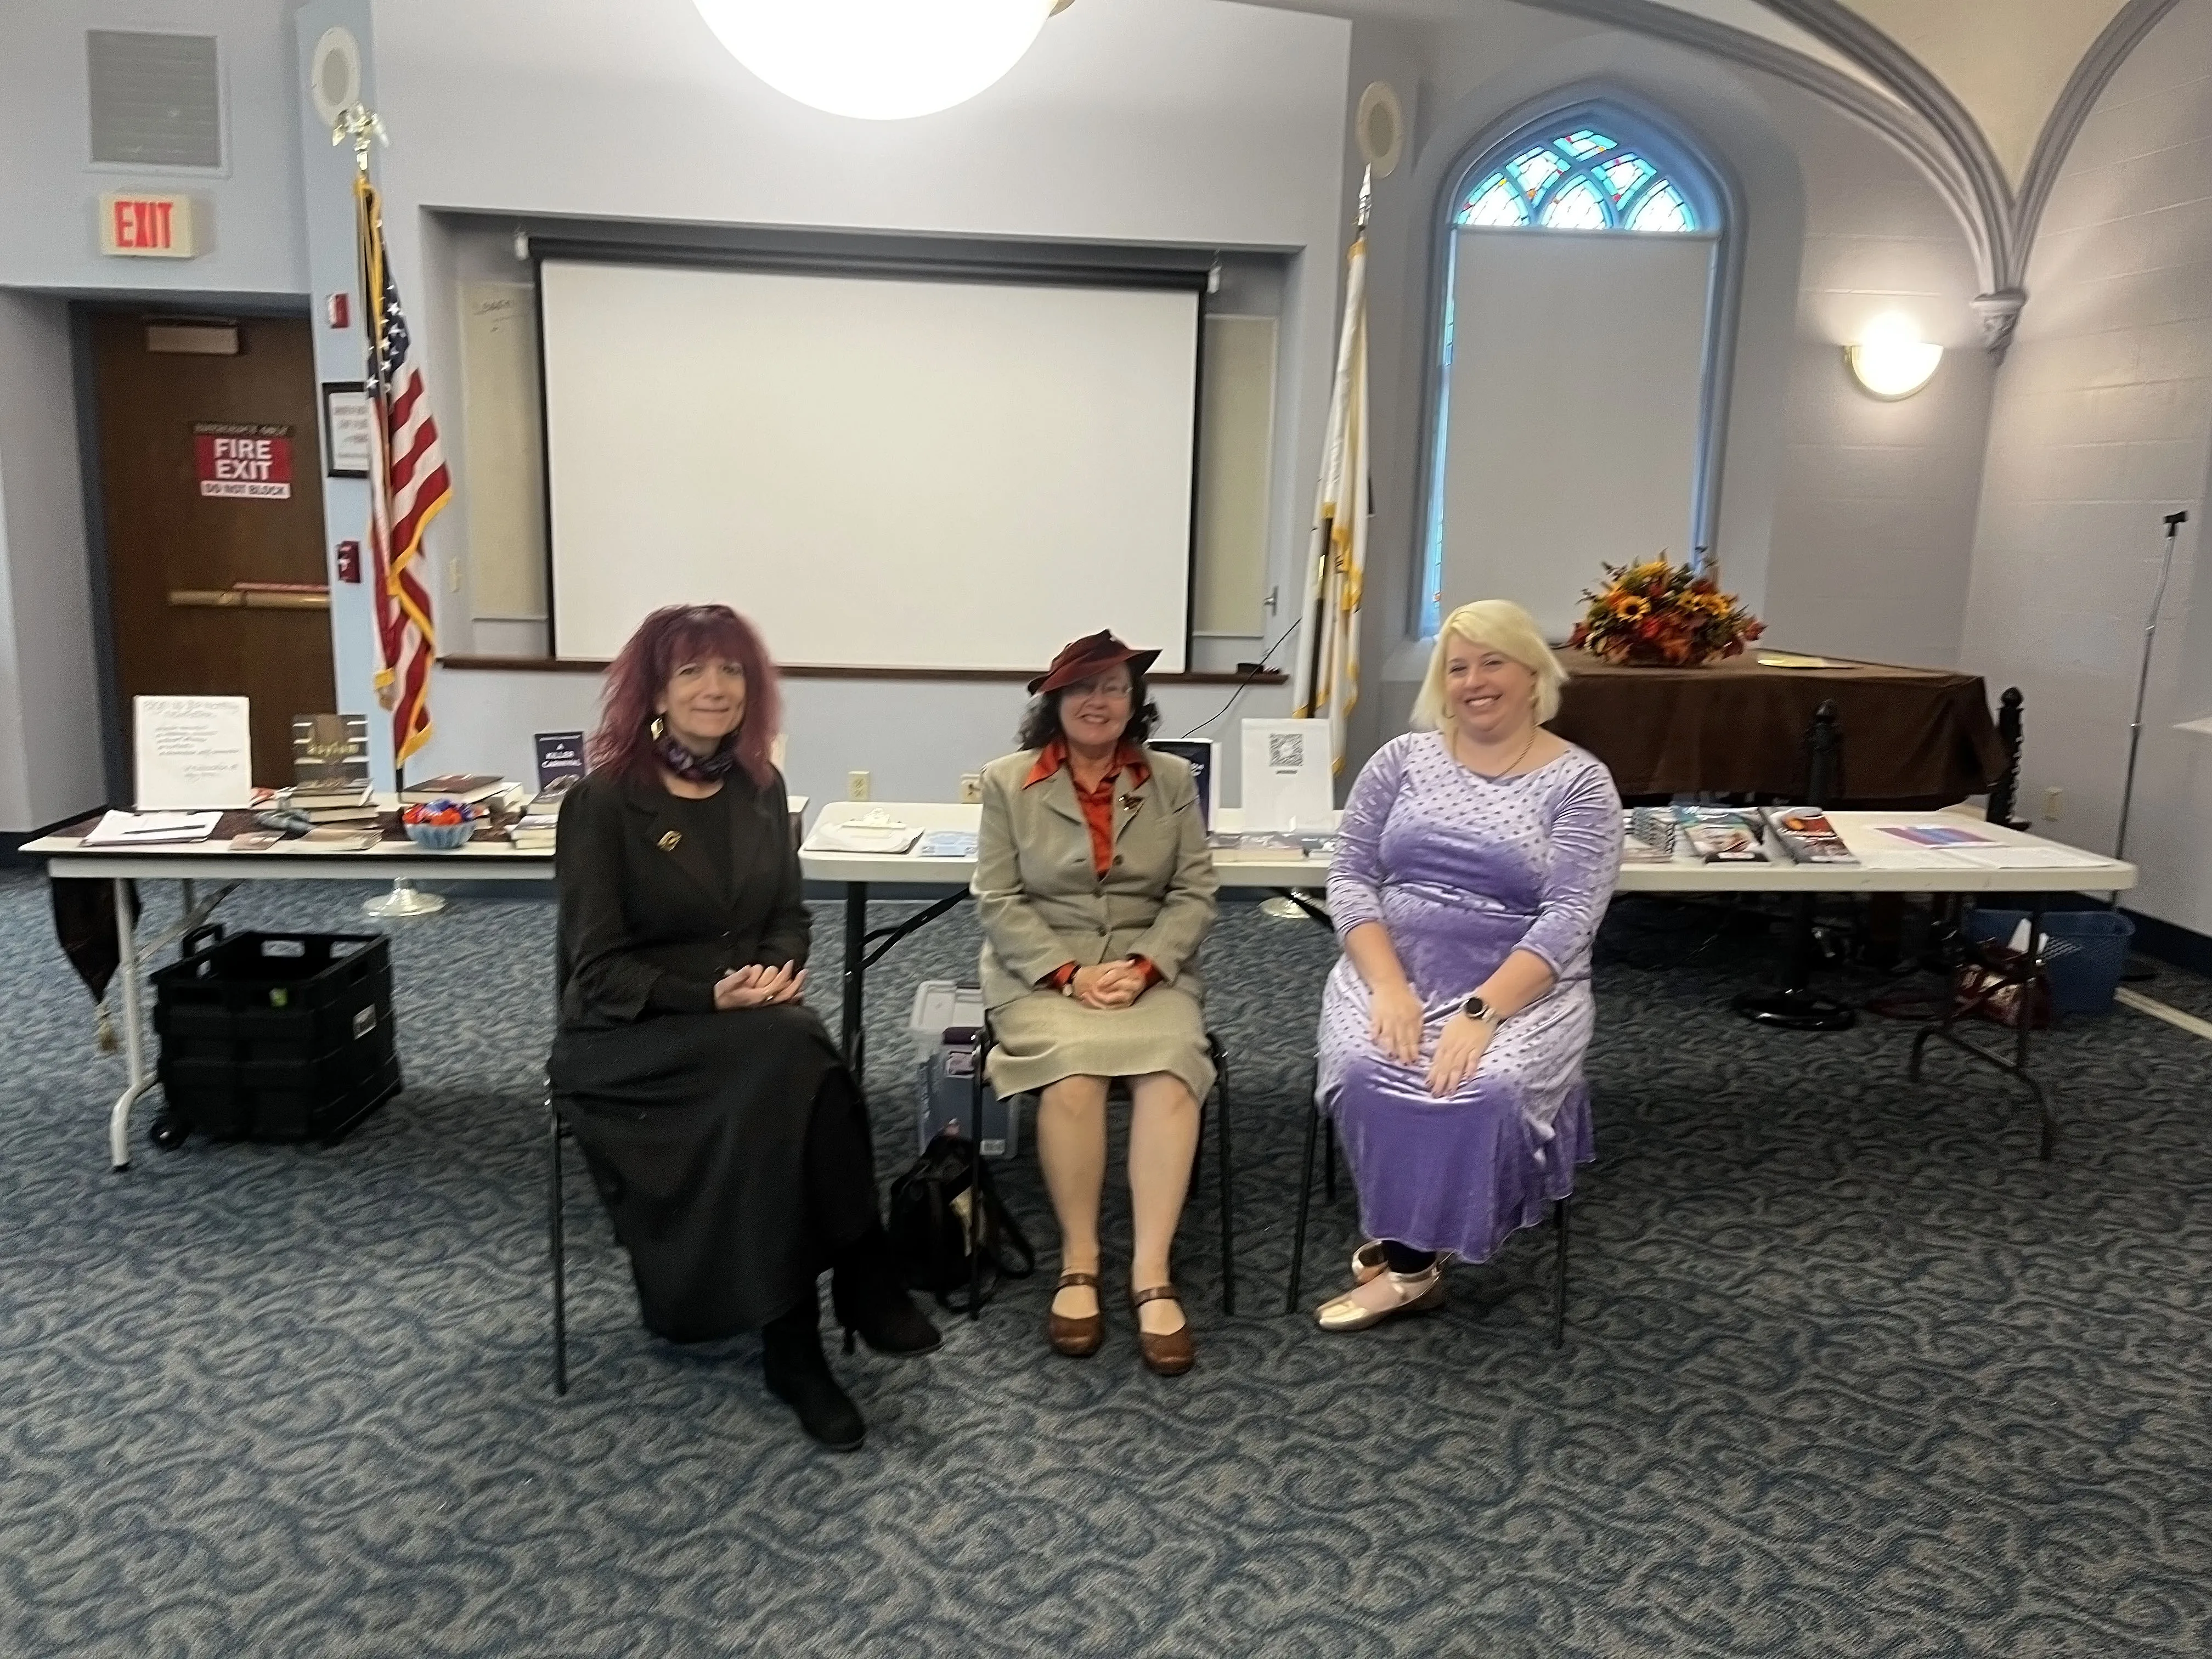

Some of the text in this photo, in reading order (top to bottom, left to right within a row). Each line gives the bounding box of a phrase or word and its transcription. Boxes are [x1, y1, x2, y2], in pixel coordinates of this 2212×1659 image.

[115, 201, 173, 247] EXIT
[214, 438, 272, 459] FIRE
[216, 460, 273, 480] EXIT
